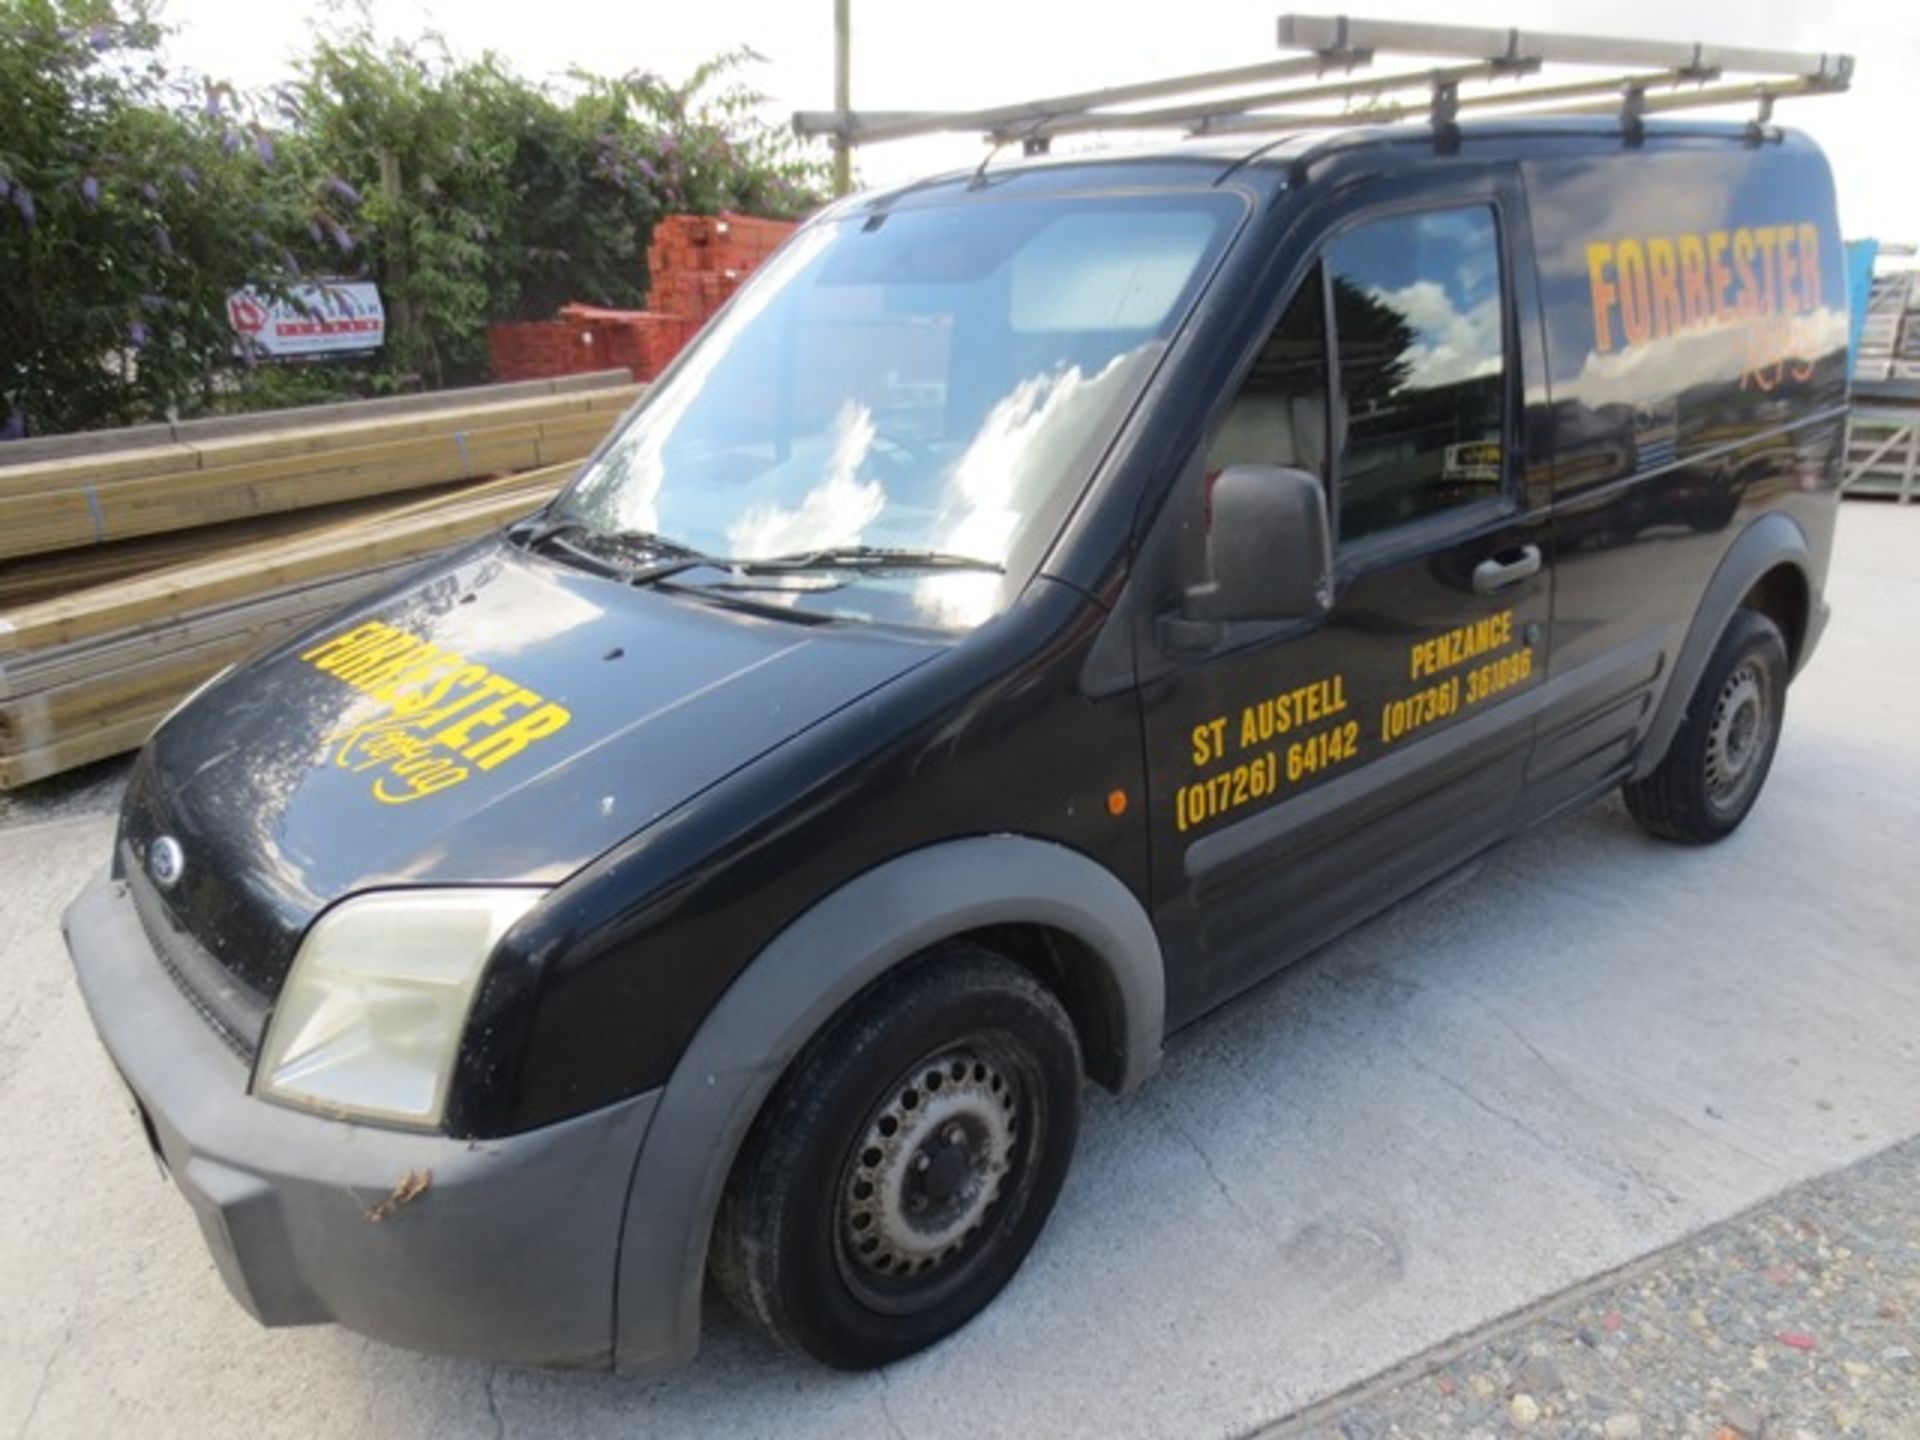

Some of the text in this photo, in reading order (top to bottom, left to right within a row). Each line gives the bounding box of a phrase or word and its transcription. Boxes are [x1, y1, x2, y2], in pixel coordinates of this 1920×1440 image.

[1585, 222, 1823, 353] FORRESTER
[300, 618, 573, 772] FORRESTER
[1410, 610, 1513, 680] PENZANCE
[1192, 674, 1347, 766] ST AUSTELL
[1381, 675, 1459, 743] (01736)
[1175, 720, 1358, 832] (01726) 64142
